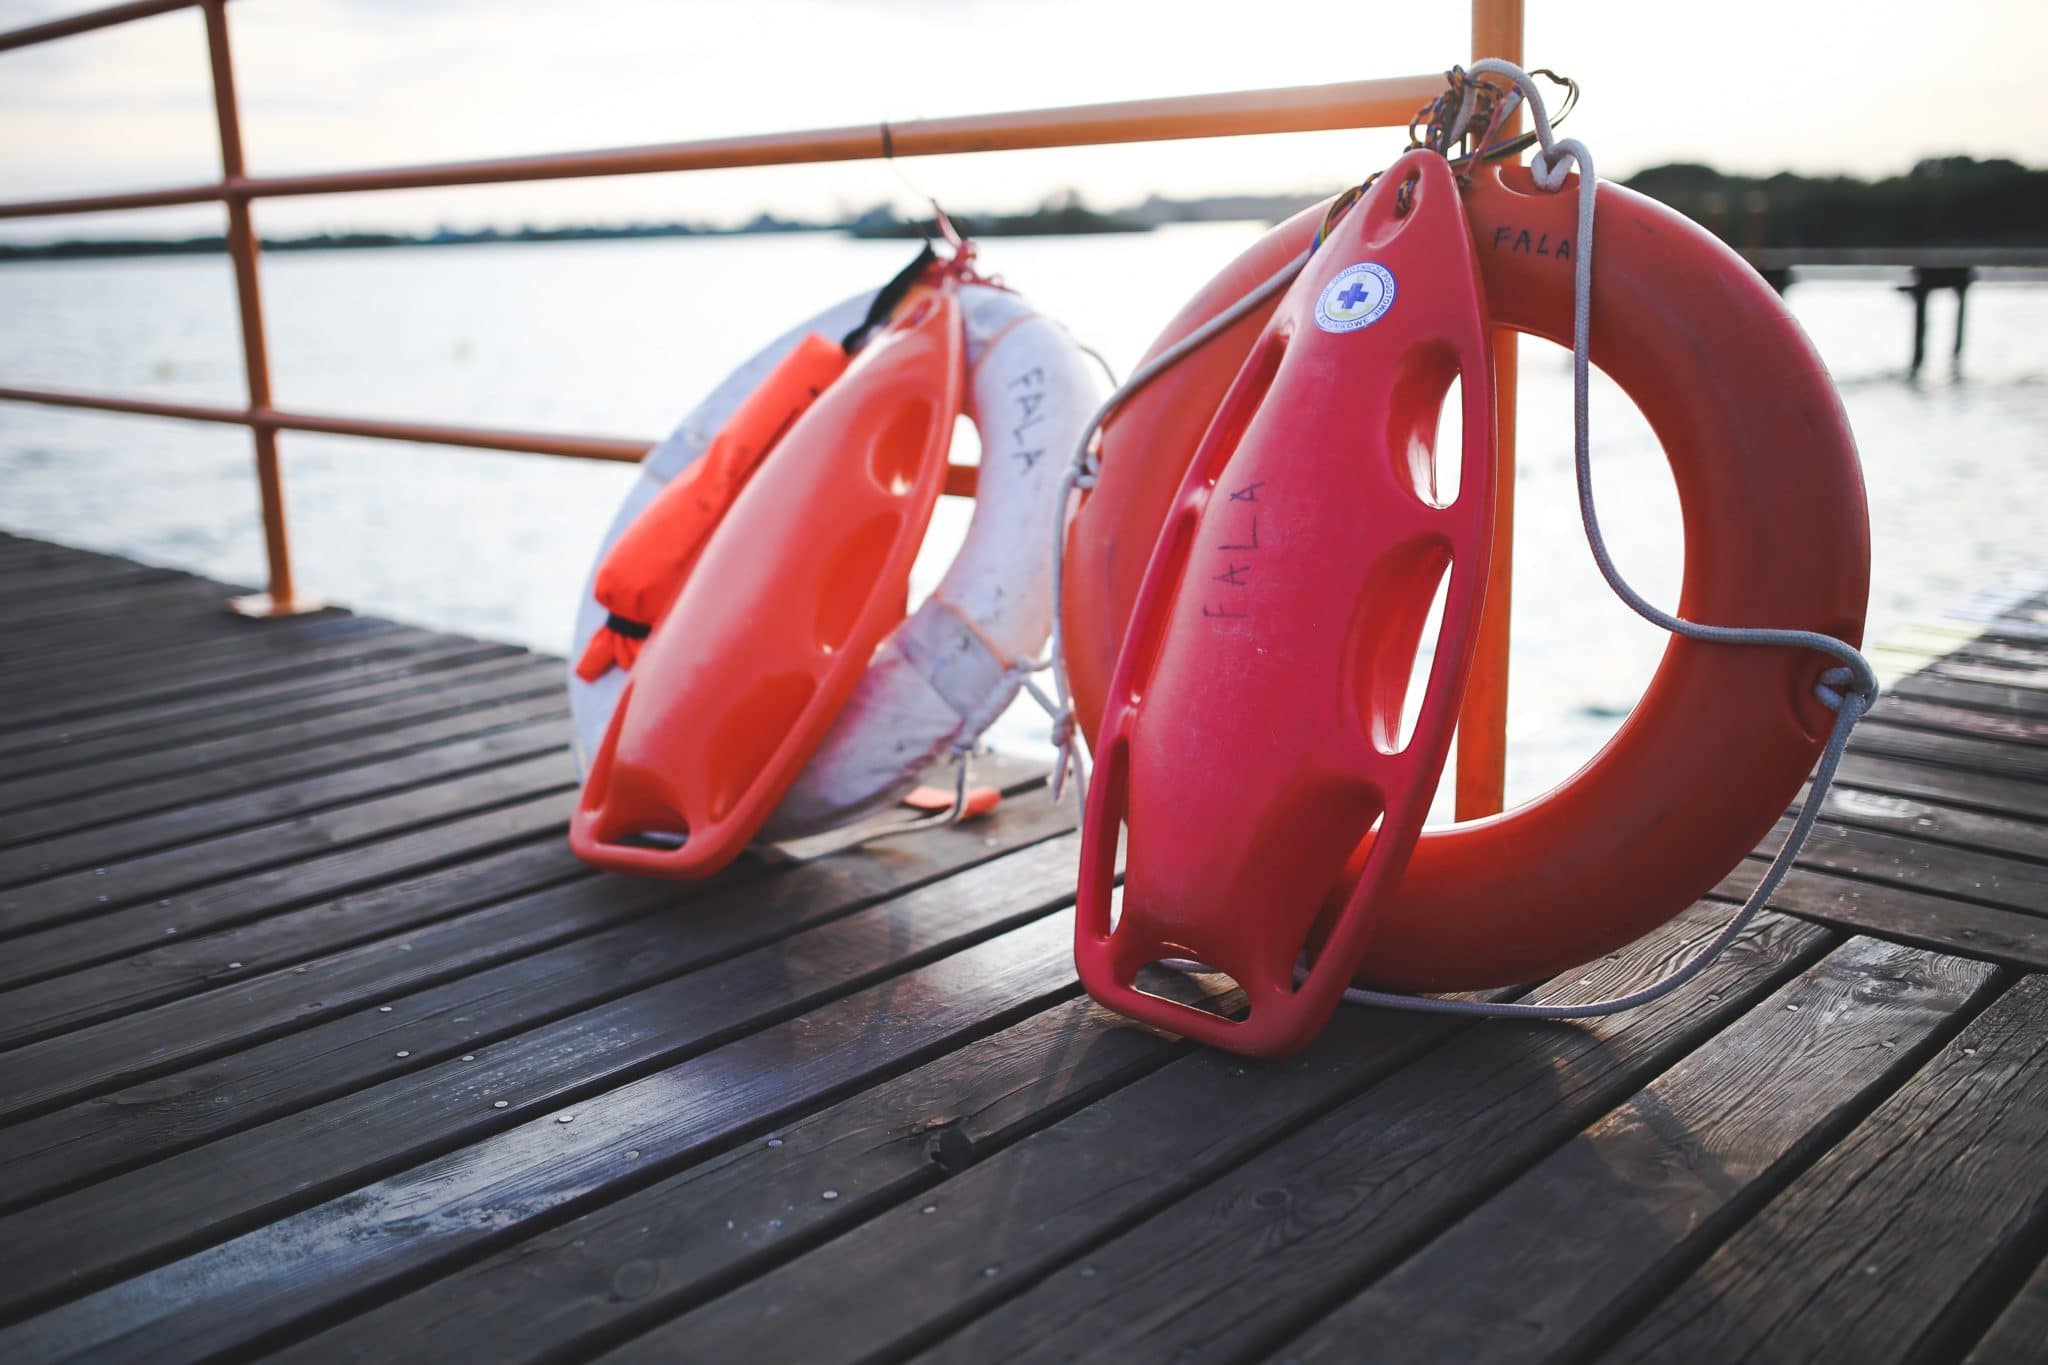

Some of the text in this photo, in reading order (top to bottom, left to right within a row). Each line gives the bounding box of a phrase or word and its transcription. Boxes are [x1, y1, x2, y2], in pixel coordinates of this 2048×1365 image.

[1493, 226, 1572, 261] FALA
[1008, 367, 1048, 477] FALA
[1202, 481, 1267, 618] FALA
